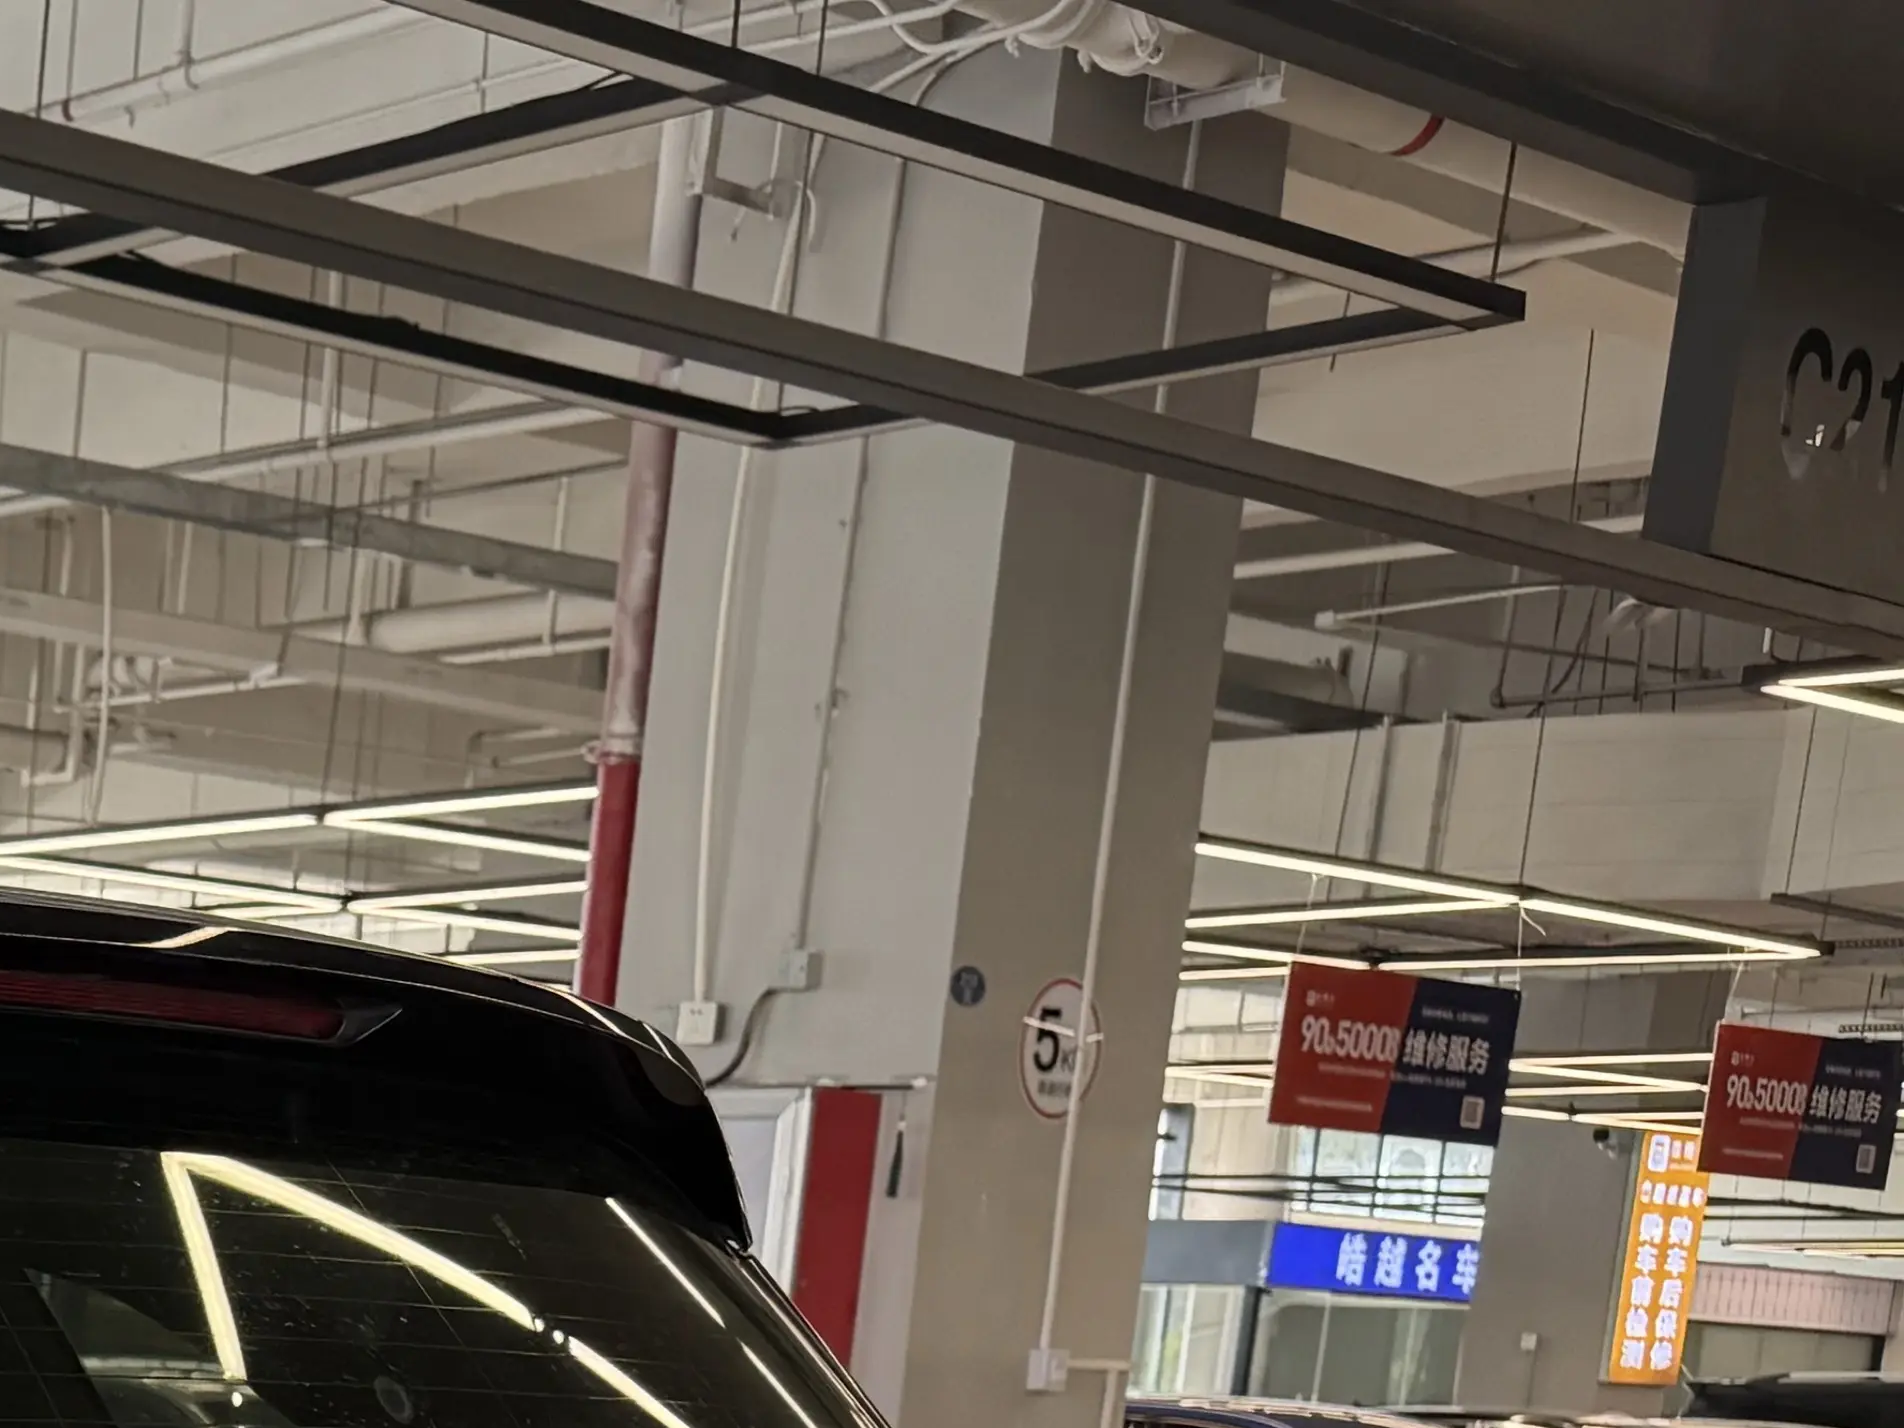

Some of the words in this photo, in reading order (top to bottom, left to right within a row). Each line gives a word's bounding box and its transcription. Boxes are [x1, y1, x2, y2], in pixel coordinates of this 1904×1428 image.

[1032, 1005, 1062, 1073] 5
[1402, 1026, 1491, 1075] 维修服务
[1809, 1083, 1883, 1125] 维修服务
[1619, 1212, 1664, 1371] 购车前检测
[1649, 1214, 1695, 1371] 购车后保修
